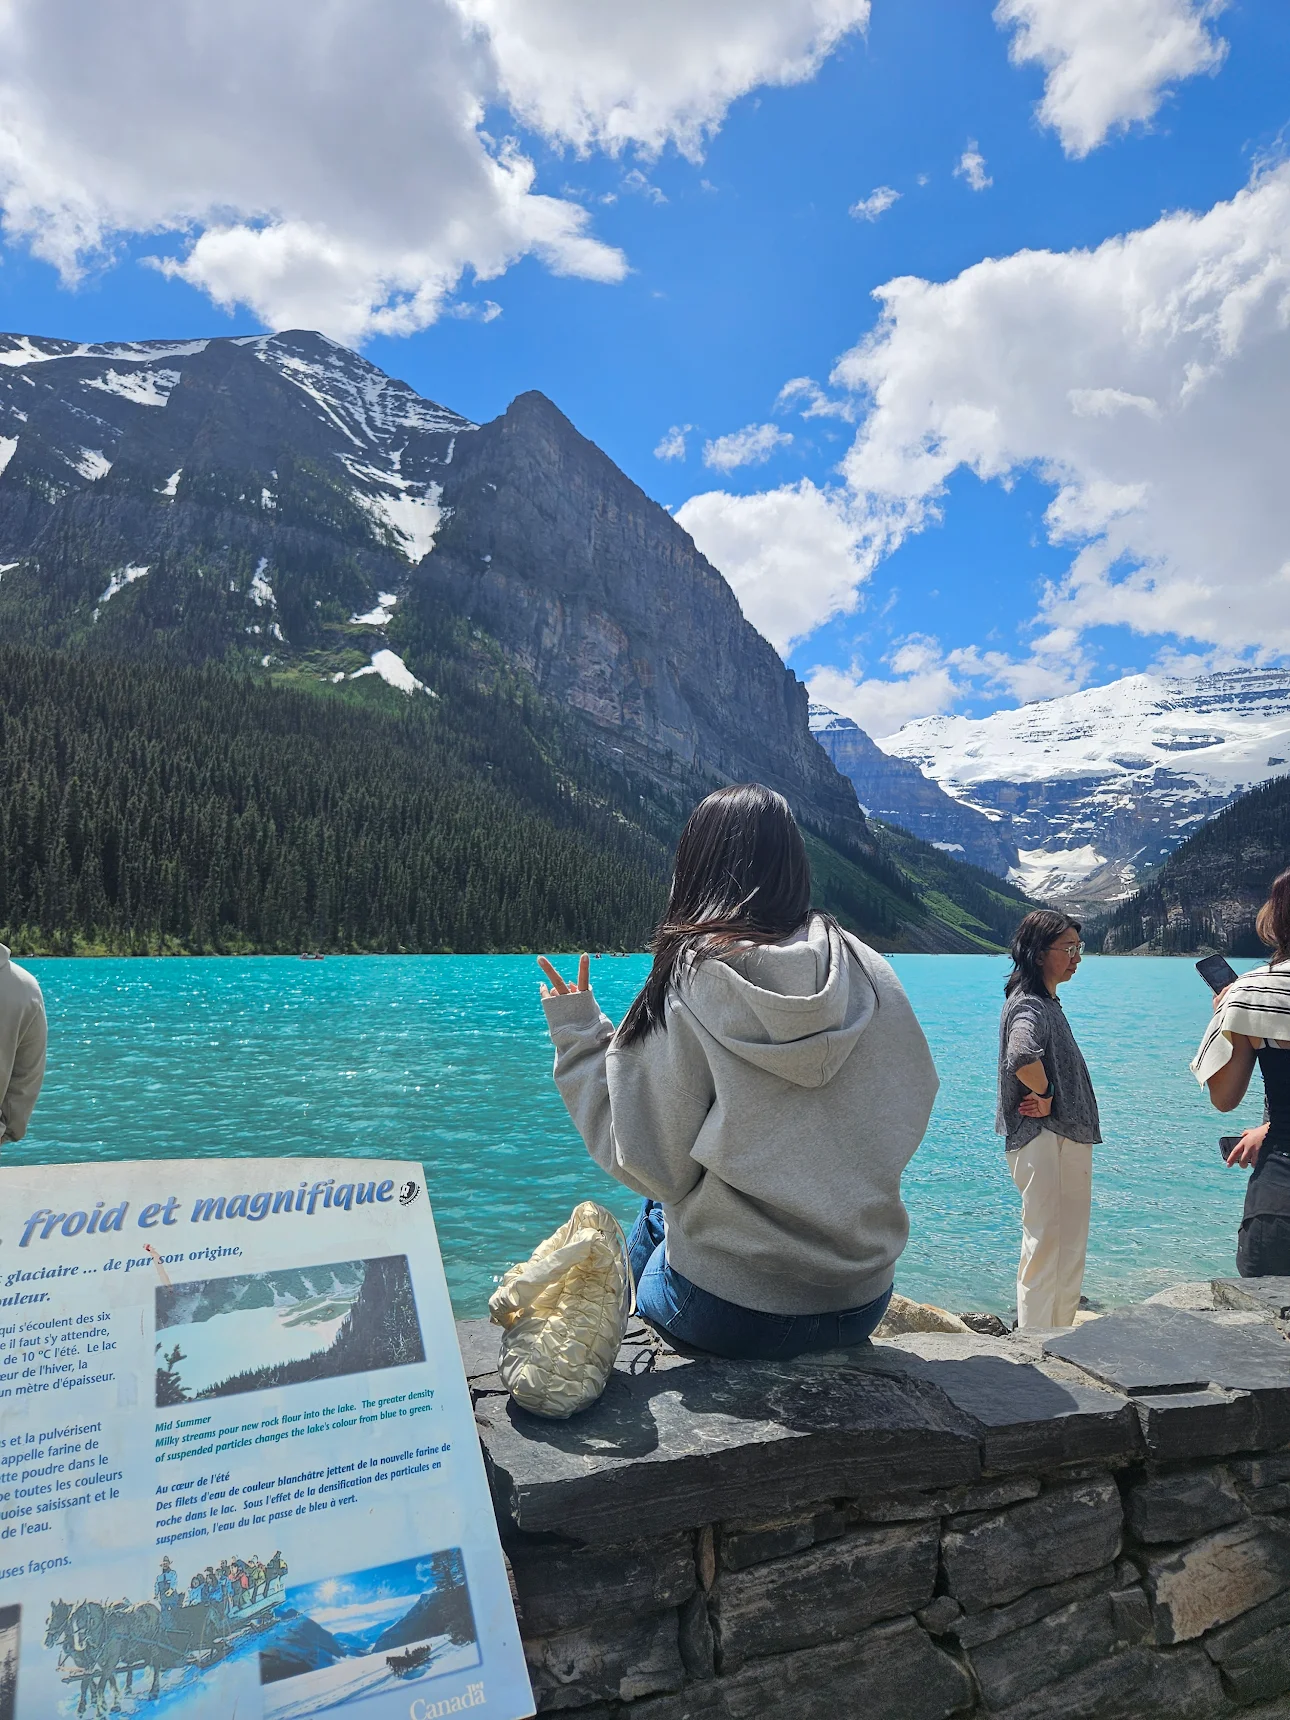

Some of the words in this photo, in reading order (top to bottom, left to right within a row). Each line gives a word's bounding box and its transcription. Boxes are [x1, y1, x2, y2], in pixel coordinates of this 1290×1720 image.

[19, 1201, 129, 1247] froid
[138, 1196, 181, 1228] et
[190, 1179, 395, 1223] magnifique
[5, 1265, 79, 1287] glaciaire
[103, 1259, 122, 1271] de
[125, 1256, 153, 1272] par
[158, 1251, 184, 1265] son
[189, 1245, 243, 1262] origine,
[0, 1292, 50, 1307] uleur.
[0, 1324, 15, 1337] qui
[19, 1317, 73, 1333] s'écoulent
[76, 1315, 94, 1324] des
[98, 1312, 110, 1321] six
[10, 1339, 15, 1348] il
[20, 1336, 41, 1347] faut
[44, 1334, 58, 1346] s'y
[61, 1328, 110, 1341] attendre,
[4, 1355, 17, 1365] de
[22, 1352, 35, 1362] 10
[55, 1345, 79, 1357] l'été.
[87, 1344, 99, 1353] Le
[103, 1341, 117, 1350] lac
[22, 1368, 36, 1378] de
[40, 1363, 74, 1375] l'hiver,
[79, 1360, 88, 1369] la
[16, 1383, 49, 1395] mètre
[53, 1372, 115, 1390] d'épaisseur.
[155, 1436, 179, 1447] Milky
[182, 1430, 216, 1442] streams
[219, 1425, 239, 1438] pour
[242, 1422, 259, 1431] new
[261, 1417, 279, 1427] rock
[282, 1412, 301, 1424] flour
[304, 1411, 319, 1420] into
[322, 1407, 335, 1416] the
[338, 1404, 356, 1413] lake.
[362, 1400, 375, 1408] The
[378, 1394, 406, 1407] greater
[408, 1389, 434, 1400] density
[155, 1421, 172, 1432] Mid
[176, 1416, 211, 1428] Summer
[0, 1439, 6, 1448] s
[10, 1436, 21, 1445] et
[26, 1433, 35, 1443] la
[39, 1422, 102, 1444] pulvérisent
[156, 1453, 167, 1463] of
[167, 1444, 213, 1461] suspended
[216, 1438, 252, 1454] particles
[255, 1431, 288, 1444] changes
[291, 1428, 304, 1437] the
[307, 1422, 330, 1434] lake's
[332, 1418, 357, 1429] colour
[359, 1415, 378, 1423] from
[380, 1411, 397, 1420] blue
[399, 1408, 407, 1416] to
[410, 1405, 432, 1416] green.
[1, 1449, 44, 1467] appelle
[48, 1444, 81, 1456] farine
[85, 1439, 98, 1450] de
[22, 1463, 65, 1482] poudre
[68, 1457, 95, 1470] dans
[99, 1455, 109, 1465] le
[156, 1501, 172, 1511] Des
[175, 1495, 198, 1507] filets
[201, 1491, 225, 1502] d'eau
[229, 1486, 239, 1496] de
[242, 1480, 275, 1494] couleur
[278, 1470, 324, 1486] blanchâtre
[326, 1463, 355, 1479] jettent
[358, 1460, 367, 1470] de
[370, 1458, 378, 1466] la
[381, 1451, 414, 1465] nouvelle
[416, 1446, 439, 1457] farine
[442, 1443, 451, 1452] de
[15, 1483, 52, 1499] toutes
[56, 1480, 71, 1491] les
[75, 1470, 123, 1487] couleurs
[156, 1485, 168, 1494] Au
[171, 1481, 194, 1492] cœur
[197, 1477, 208, 1486] de
[211, 1471, 230, 1484] l'été
[37, 1494, 91, 1513] saisissant
[95, 1490, 106, 1501] et
[110, 1488, 120, 1499] le
[156, 1515, 182, 1528] roche
[185, 1510, 207, 1522] dans
[210, 1507, 218, 1516] le
[221, 1504, 237, 1514] lac.
[243, 1499, 263, 1510] Sous
[266, 1492, 291, 1505] l'effet
[294, 1489, 305, 1499] de
[308, 1487, 316, 1496] la
[318, 1476, 372, 1494] densification
[375, 1472, 388, 1482] des
[391, 1464, 429, 1481] particules
[1, 1527, 16, 1539] de
[21, 1521, 52, 1535] l'eau.
[156, 1528, 209, 1545] suspension,
[213, 1522, 235, 1532] l'eau
[238, 1517, 249, 1527] du
[253, 1515, 266, 1524] lac
[268, 1509, 293, 1524] passe
[296, 1505, 306, 1515] de
[309, 1502, 327, 1512] bleu
[330, 1498, 336, 1507] à
[339, 1494, 358, 1505] vert.
[28, 1556, 72, 1574] façons.
[410, 1681, 486, 1720] Canada
